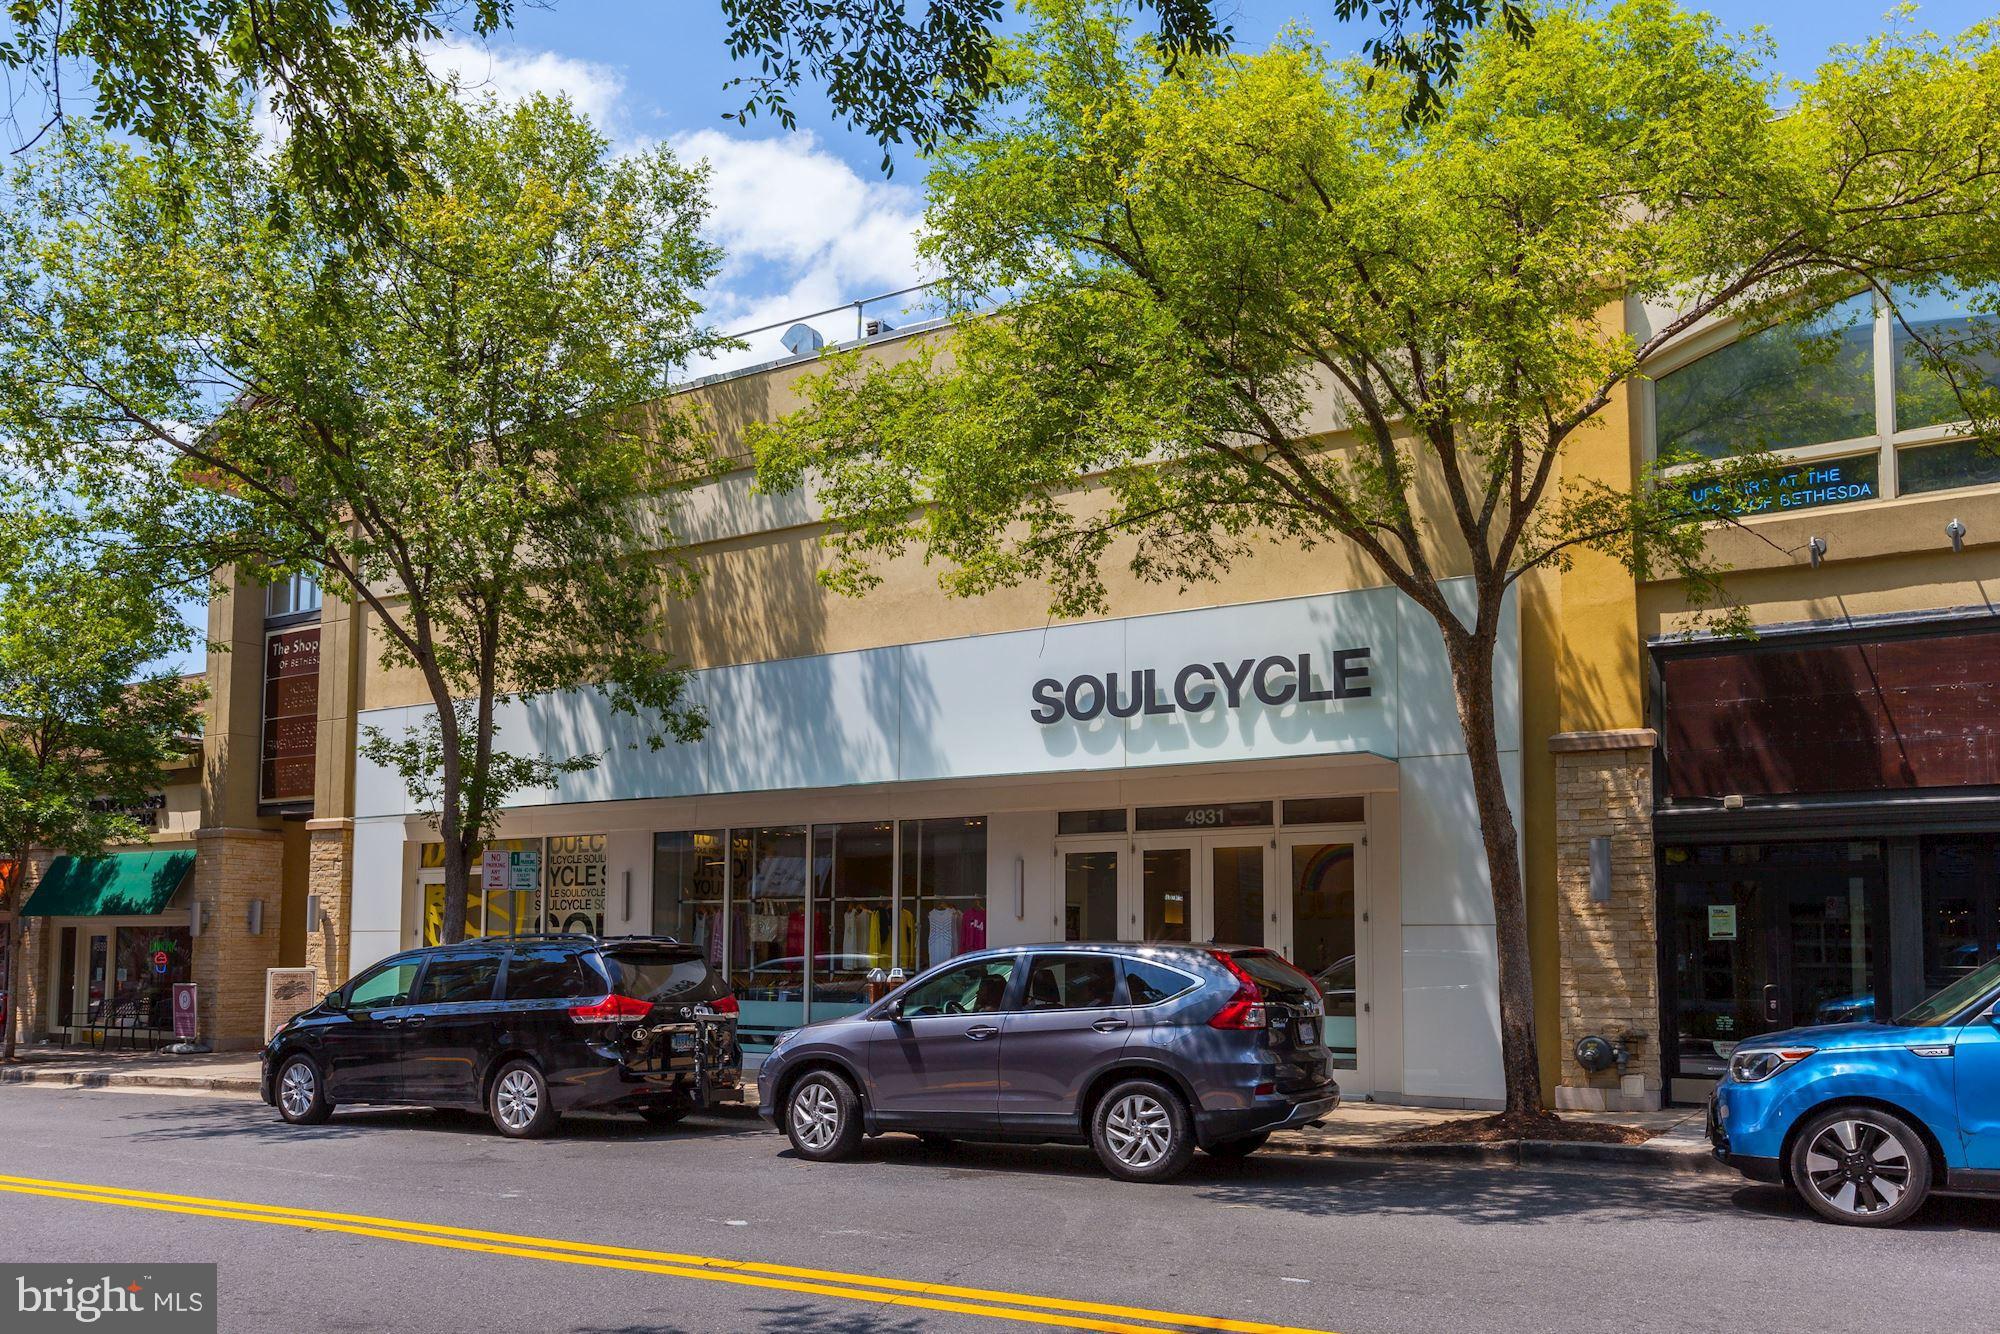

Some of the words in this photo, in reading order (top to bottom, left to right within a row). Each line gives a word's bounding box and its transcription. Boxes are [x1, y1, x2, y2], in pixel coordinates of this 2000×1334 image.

[1779, 474, 1798, 488] AT
[1808, 468, 1840, 484] THE
[1780, 483, 1872, 507] BETHESDA
[273, 642, 290, 656] The
[293, 639, 320, 654] Shop
[280, 660, 289, 669] OF
[1030, 647, 1372, 725] SOULCYCLE
[1185, 809, 1224, 825] 4931
[491, 853, 501, 862] NO
